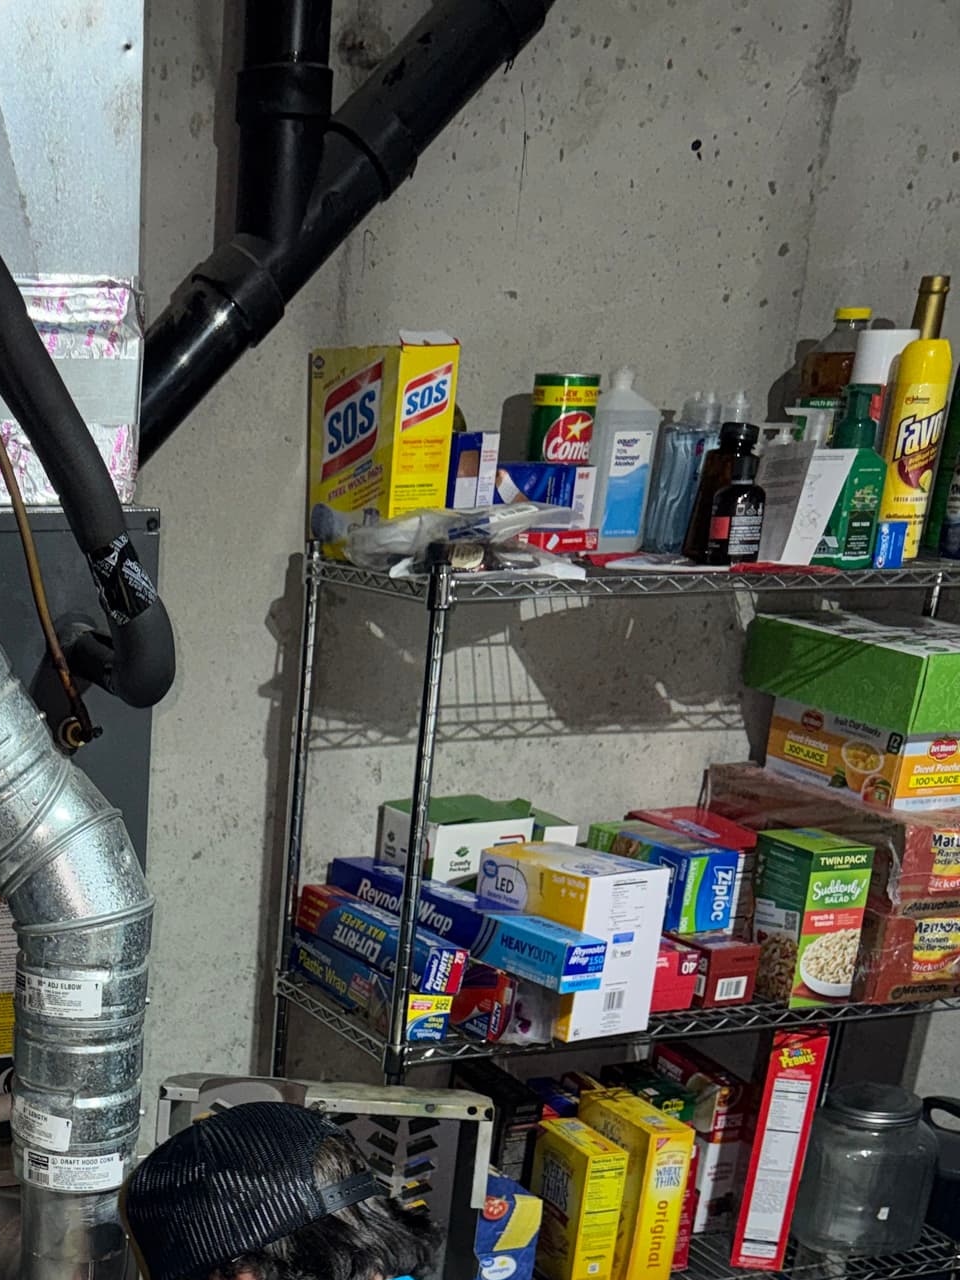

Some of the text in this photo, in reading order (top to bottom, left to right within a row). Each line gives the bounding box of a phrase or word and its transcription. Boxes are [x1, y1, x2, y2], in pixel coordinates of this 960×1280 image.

[547, 436, 590, 460] Come
[804, 750, 825, 763] JUICE
[934, 776, 959, 785] JUICE
[450, 860, 471, 868] Comfy
[820, 854, 868, 865] TWIN PACK
[495, 877, 514, 894] LED
[710, 870, 732, 921] Ziploc
[824, 896, 850, 904] SALAD
[357, 878, 402, 914] Reynol
[417, 900, 453, 935] Wrap
[341, 911, 366, 932] PAPER
[332, 924, 382, 963] CUT-RITE
[681, 962, 697, 974] 40
[325, 965, 348, 993] Wrap
[647, 1200, 669, 1269] original
